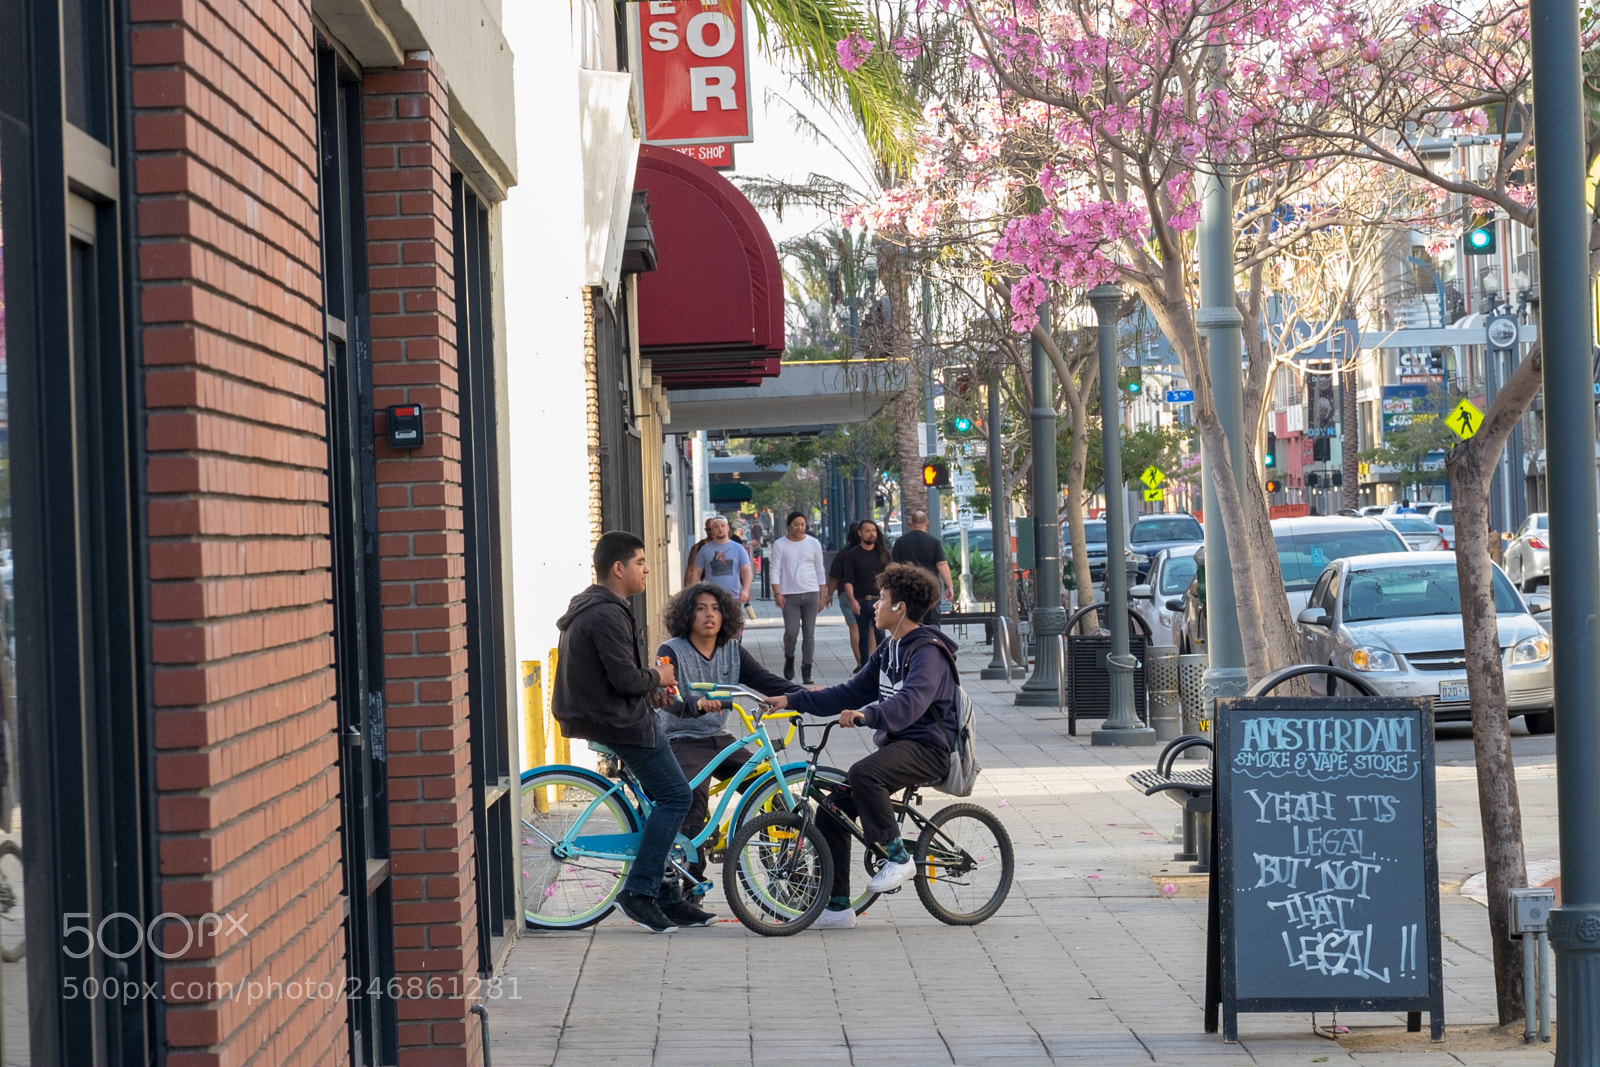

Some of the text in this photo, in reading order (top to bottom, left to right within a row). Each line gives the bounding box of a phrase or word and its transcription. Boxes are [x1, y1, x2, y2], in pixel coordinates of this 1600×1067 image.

[698, 145, 726, 160] SHOP
[1241, 717, 1416, 752] AMSTERDAM
[1234, 751, 1409, 773] SMOKE & VAPE STORE
[1244, 789, 1337, 824] YEAH
[1315, 860, 1381, 899] NOT
[1267, 890, 1355, 932] THAT
[1281, 923, 1391, 984] LEGAL
